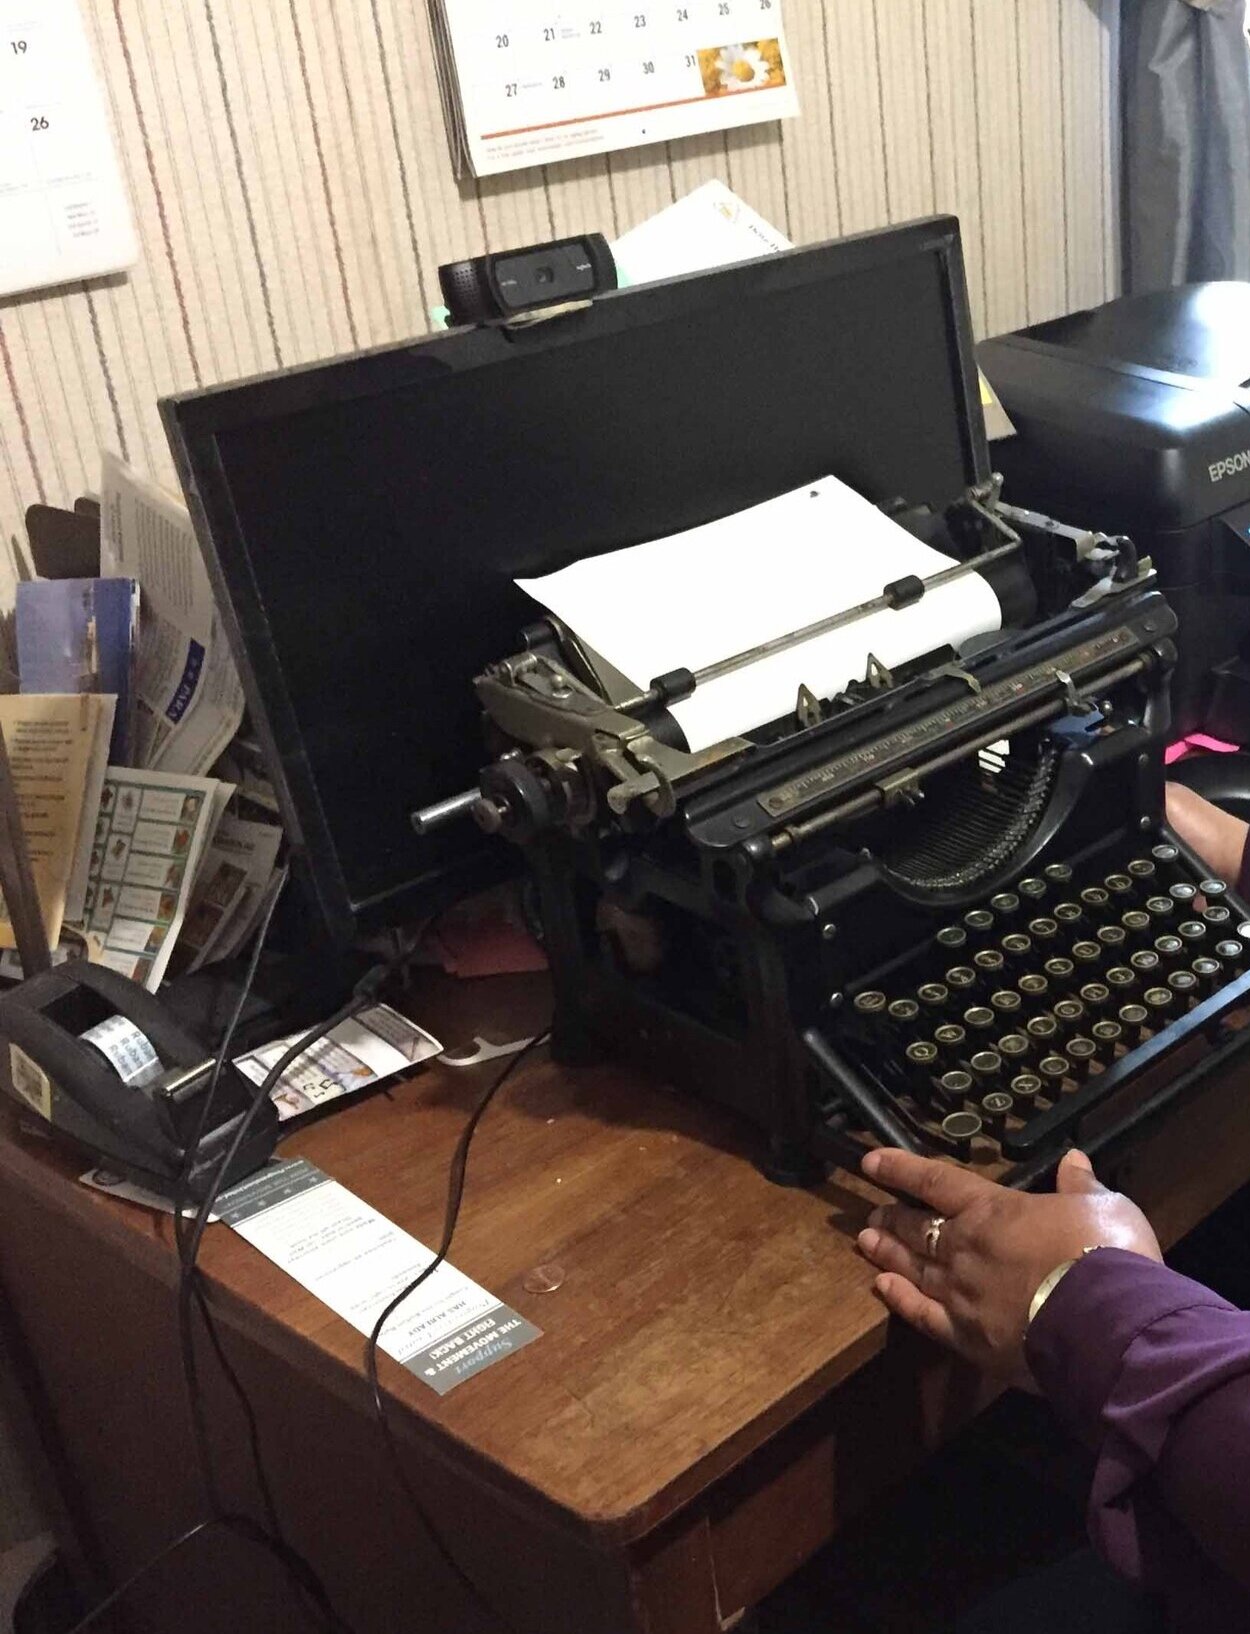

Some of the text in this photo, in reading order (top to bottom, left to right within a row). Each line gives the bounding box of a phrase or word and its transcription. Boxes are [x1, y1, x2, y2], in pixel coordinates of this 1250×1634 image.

[495, 34, 509, 48] 20
[543, 28, 556, 42] 21
[589, 21, 602, 35] 22
[634, 15, 647, 29] 23
[676, 9, 689, 22] 24
[718, 2, 730, 16] 25
[10, 40, 27, 55] 19
[505, 83, 518, 97] 27
[552, 76, 565, 90] 28
[597, 69, 611, 83] 29
[642, 61, 655, 75] 30
[685, 54, 697, 68] 31
[30, 116, 50, 132] 26
[464, 1317, 497, 1342] FIGHT
[424, 1317, 522, 1377] THE MOVEMENT &
[428, 1337, 465, 1361] BACK!
[455, 1336, 513, 1376] Support
